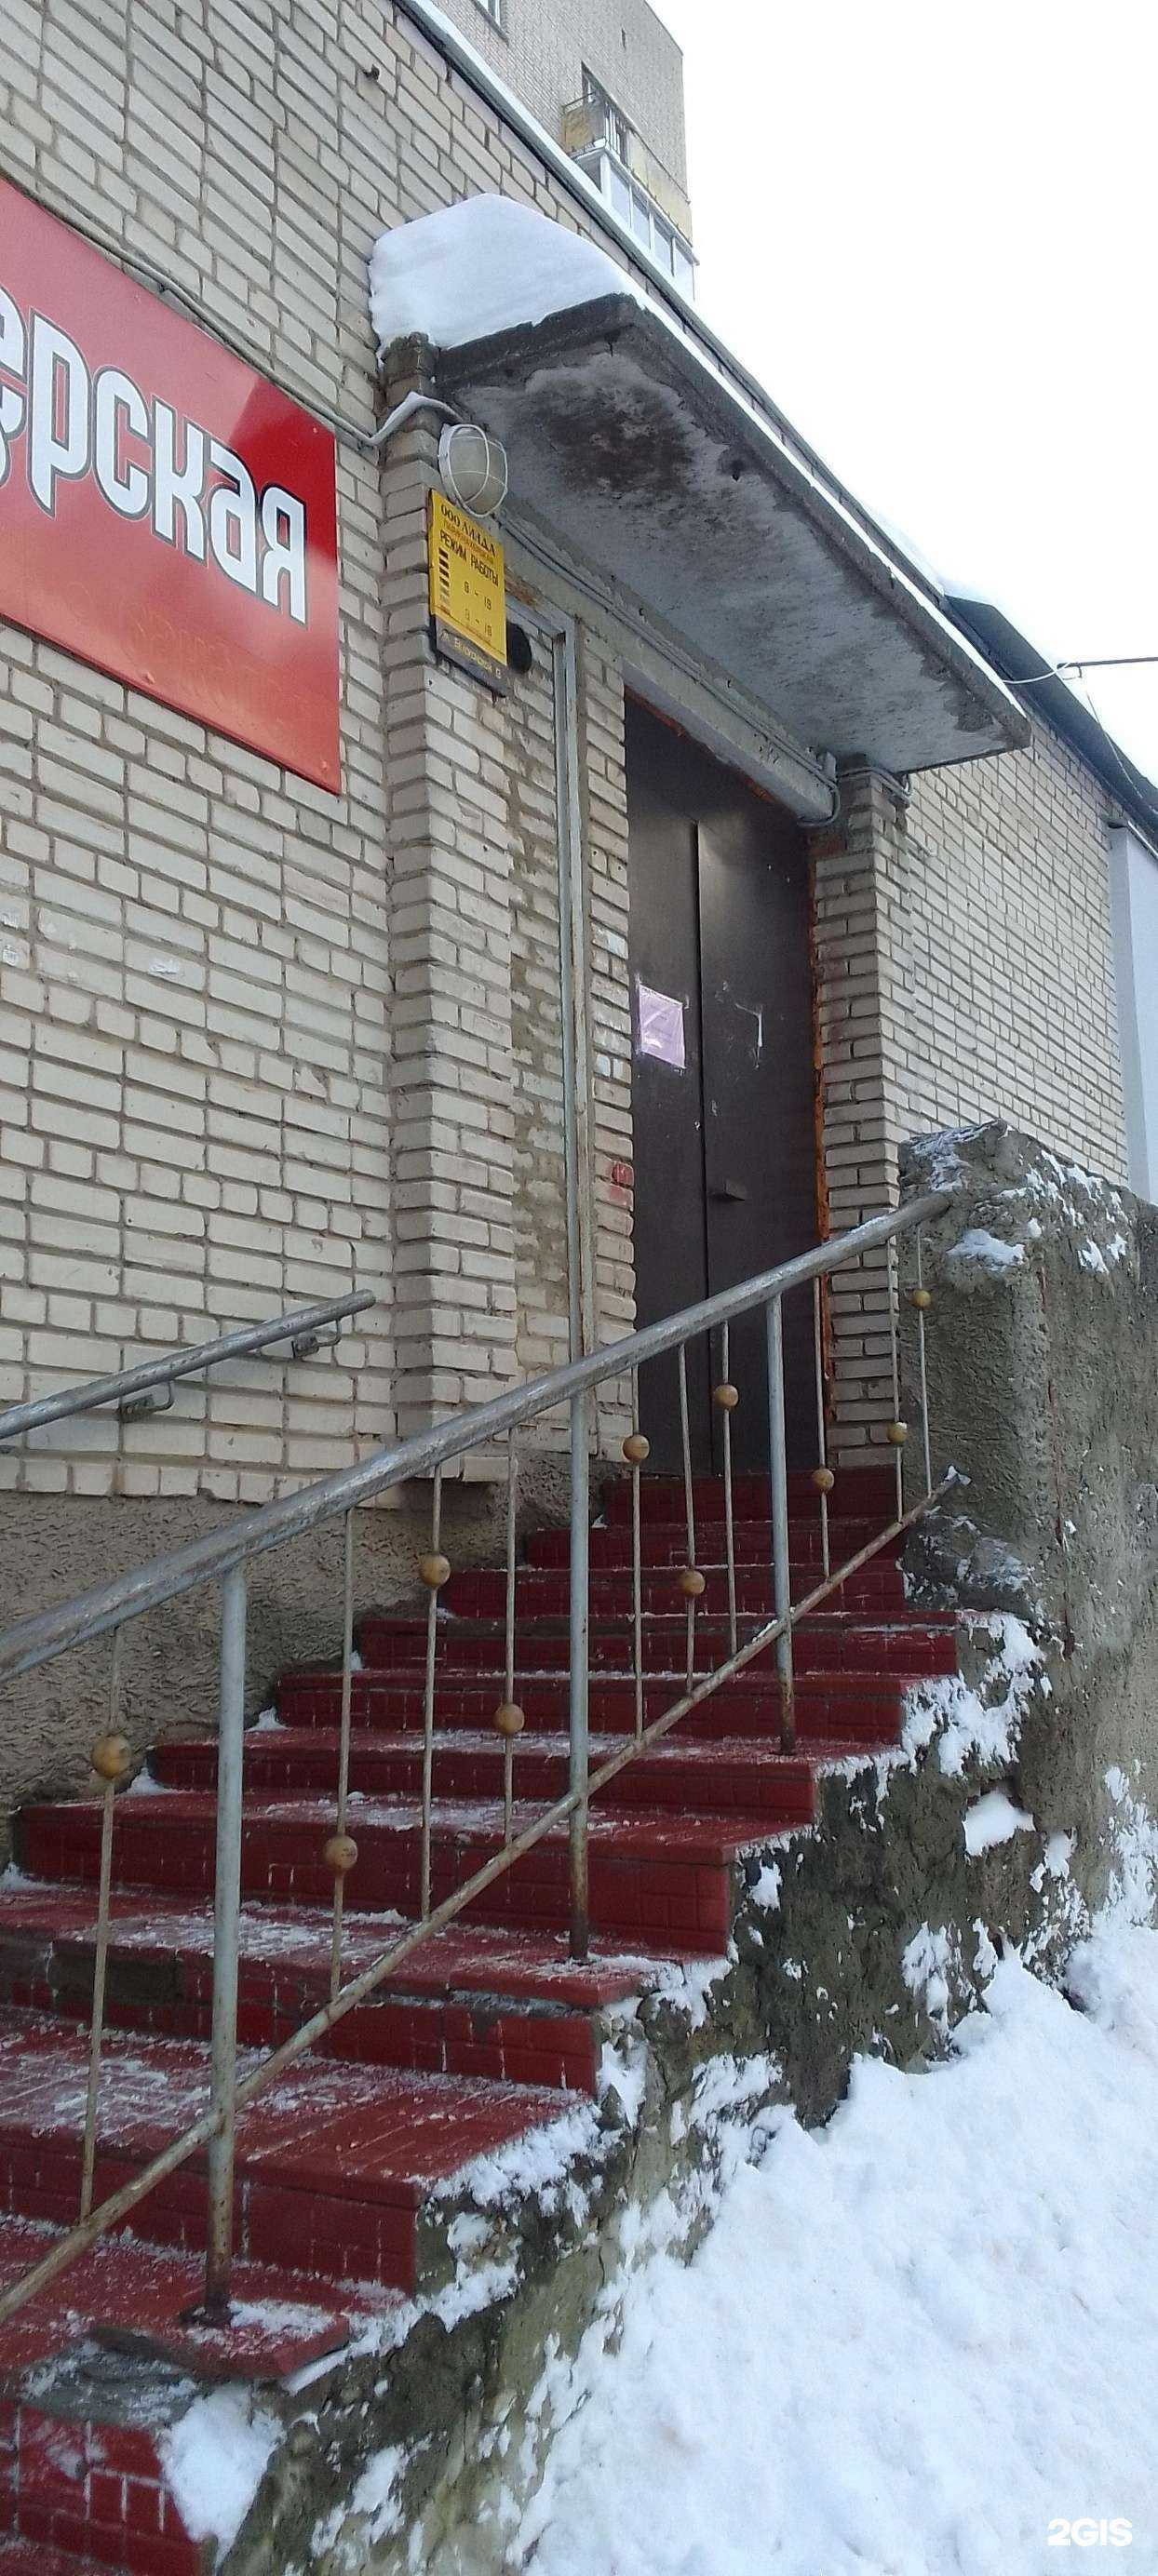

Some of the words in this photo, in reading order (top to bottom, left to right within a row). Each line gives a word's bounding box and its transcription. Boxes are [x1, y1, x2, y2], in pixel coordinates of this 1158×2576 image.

[441, 504, 460, 527] ООО
[439, 529, 467, 561] РЕЖИМ
[471, 553, 499, 586] РАБОТЫ
